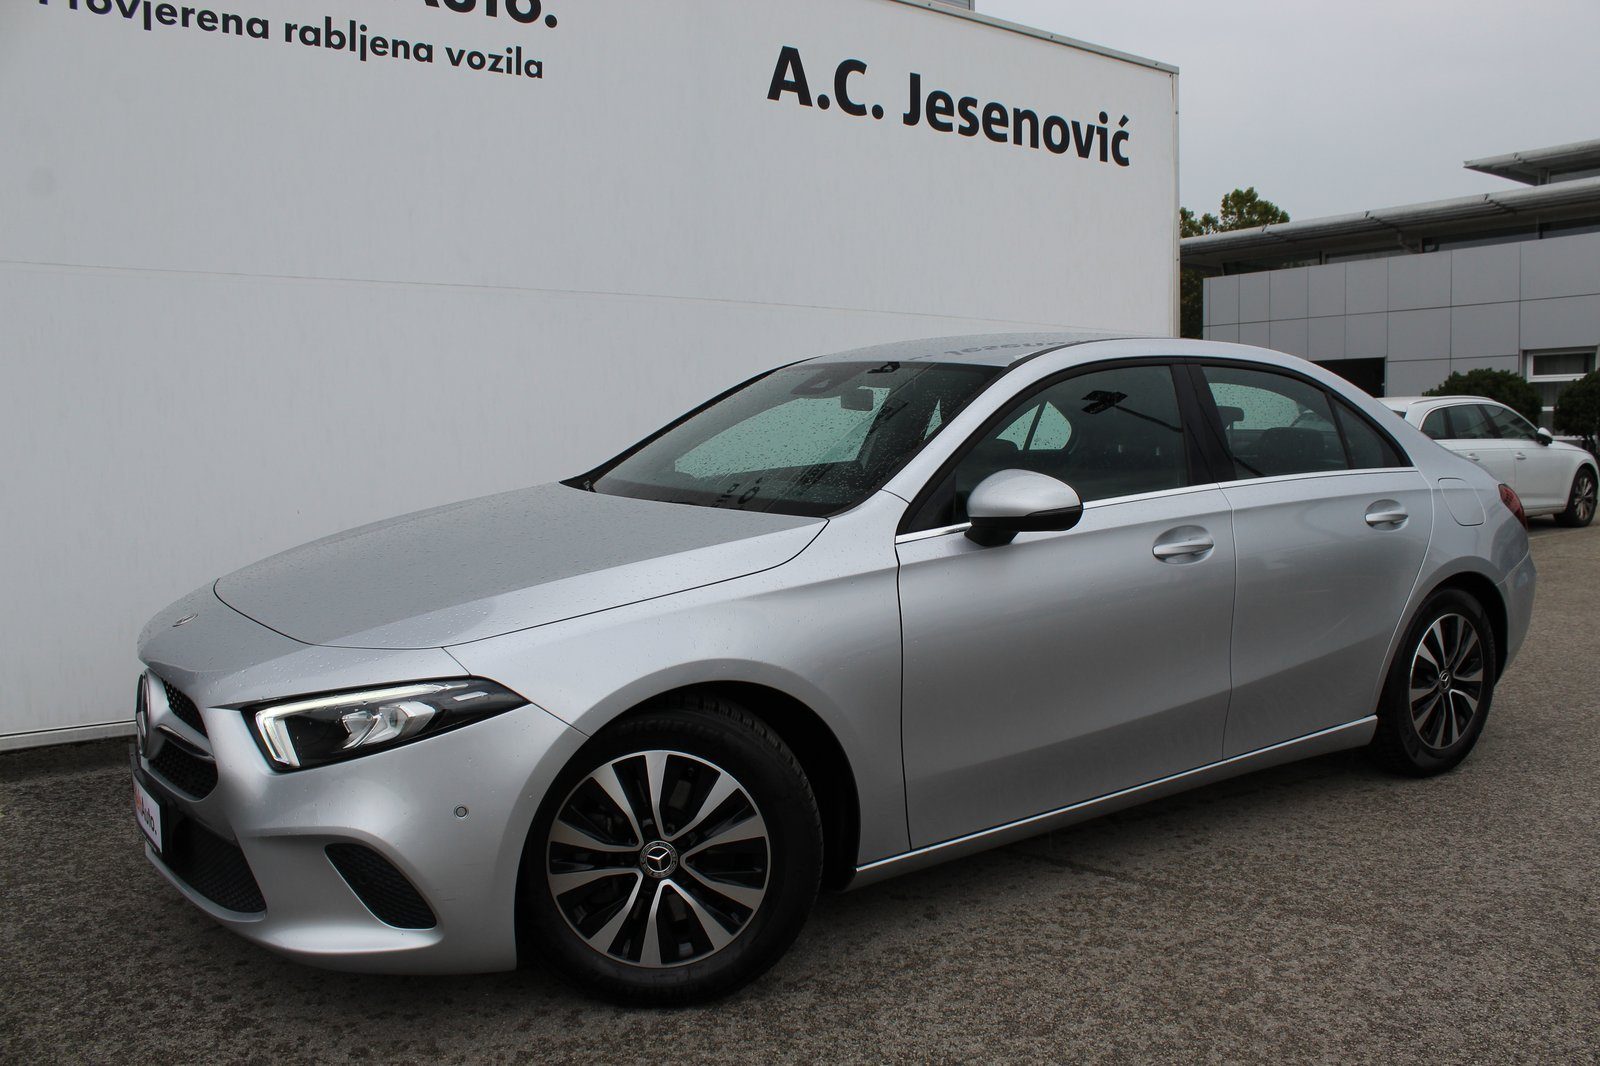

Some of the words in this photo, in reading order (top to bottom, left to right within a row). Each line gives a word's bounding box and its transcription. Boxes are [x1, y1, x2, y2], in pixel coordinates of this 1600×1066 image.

[285, 16, 434, 63] rabljena
[446, 46, 543, 79] vozila
[767, 46, 884, 120] A.C.
[902, 72, 1130, 167] Jesenović
